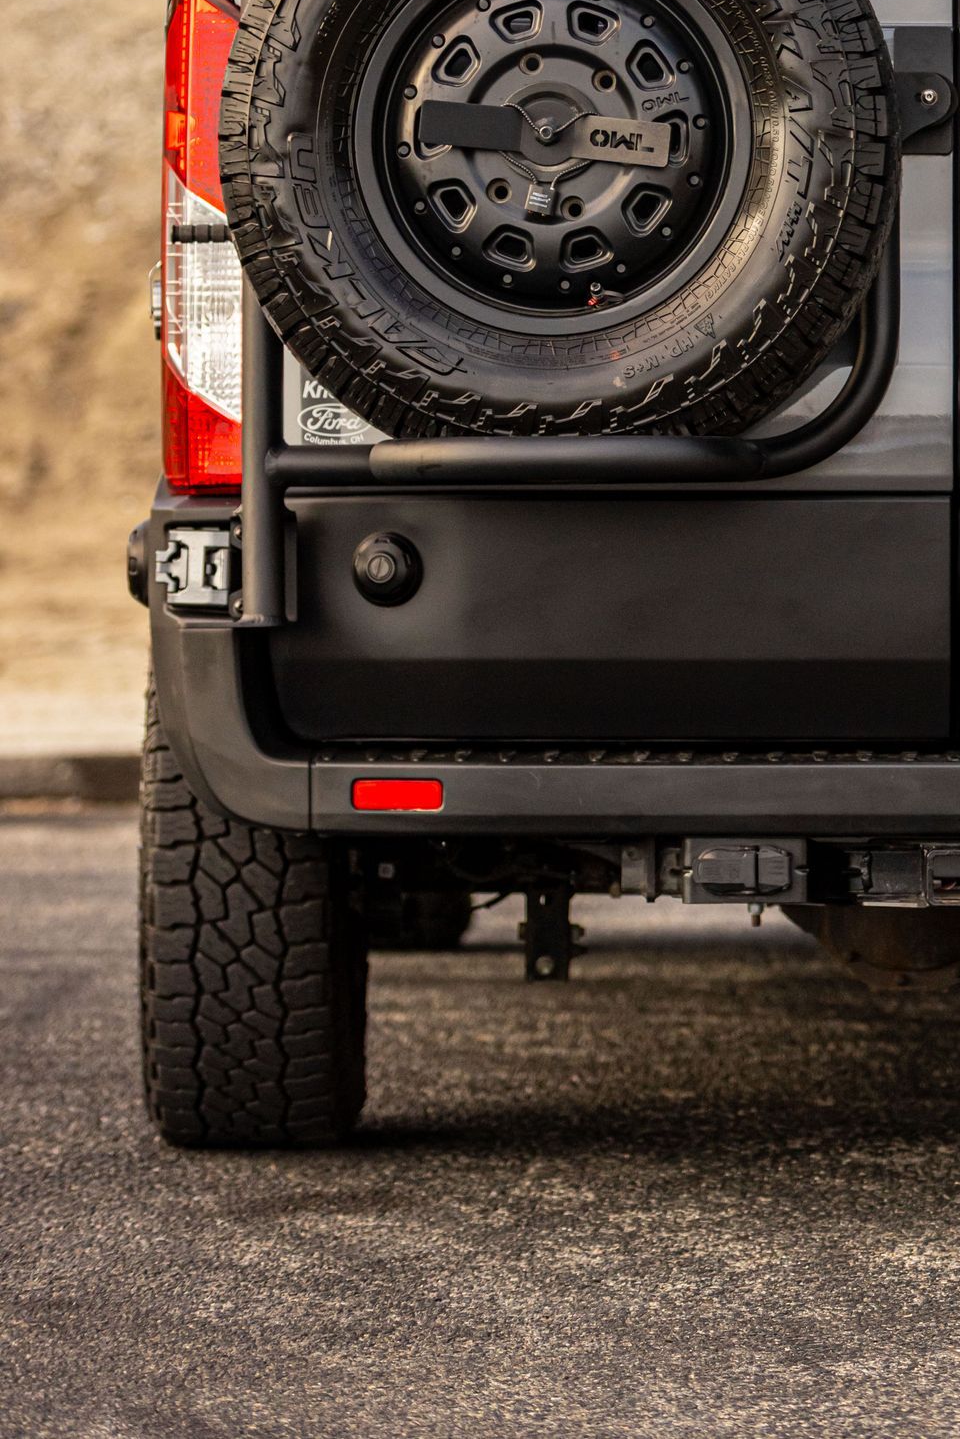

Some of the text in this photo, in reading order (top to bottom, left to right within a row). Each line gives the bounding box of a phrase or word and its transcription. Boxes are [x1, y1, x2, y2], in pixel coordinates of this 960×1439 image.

[589, 129, 655, 153] OWL
[302, 380, 334, 399] Kn
[306, 407, 363, 430] Ford
